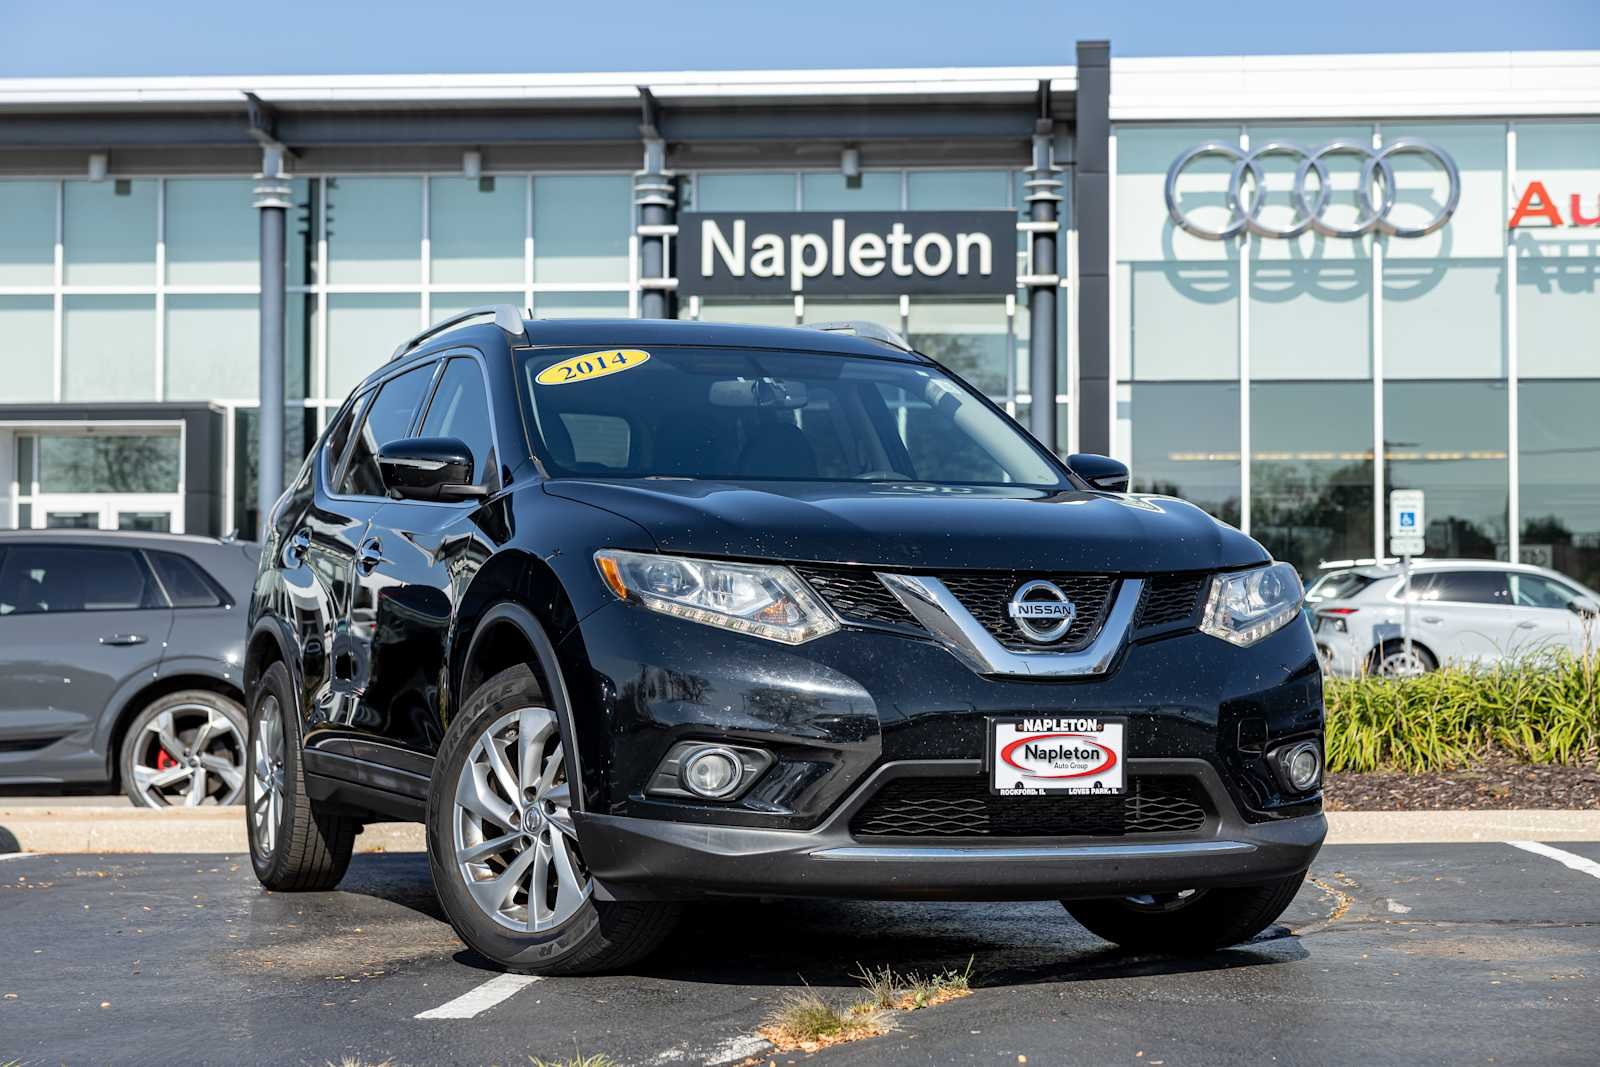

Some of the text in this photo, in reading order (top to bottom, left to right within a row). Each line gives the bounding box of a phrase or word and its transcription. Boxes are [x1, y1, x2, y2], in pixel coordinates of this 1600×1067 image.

[701, 219, 992, 291] Napleton
[559, 351, 627, 380] 2014
[1018, 605, 1071, 615] NISSAN
[1023, 719, 1097, 732] NAPLETON
[1024, 744, 1100, 763] Napleton
[1070, 762, 1088, 770] Group
